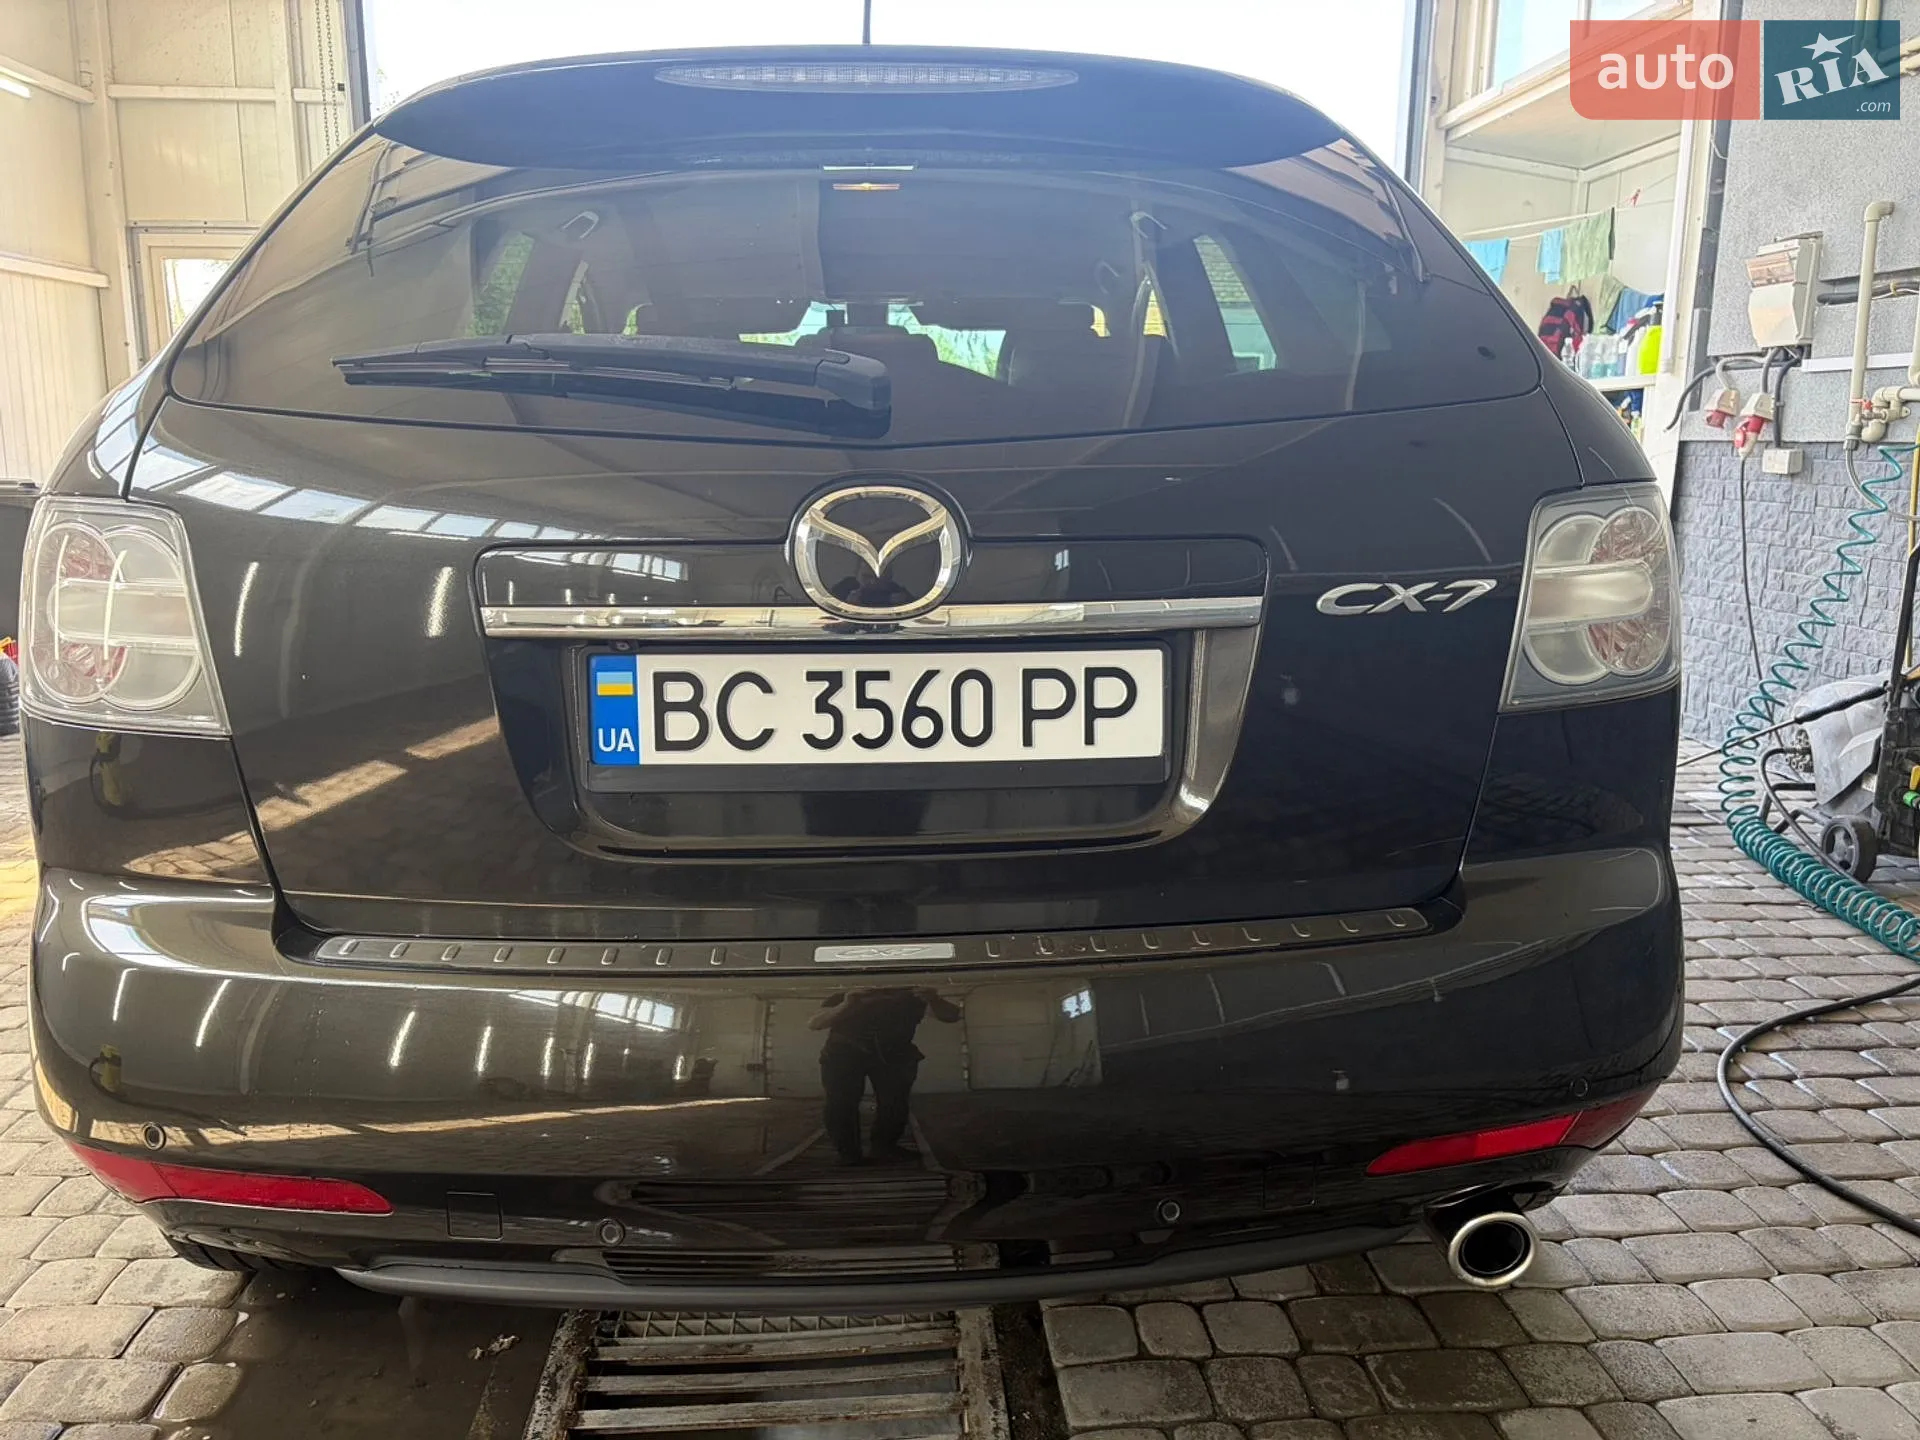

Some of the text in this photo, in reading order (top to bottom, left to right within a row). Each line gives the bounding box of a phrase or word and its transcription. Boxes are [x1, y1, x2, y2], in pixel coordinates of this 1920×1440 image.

[1316, 579, 1498, 616] CX-7
[652, 666, 1138, 751] BC 3560 PP
[597, 727, 636, 752] UA
